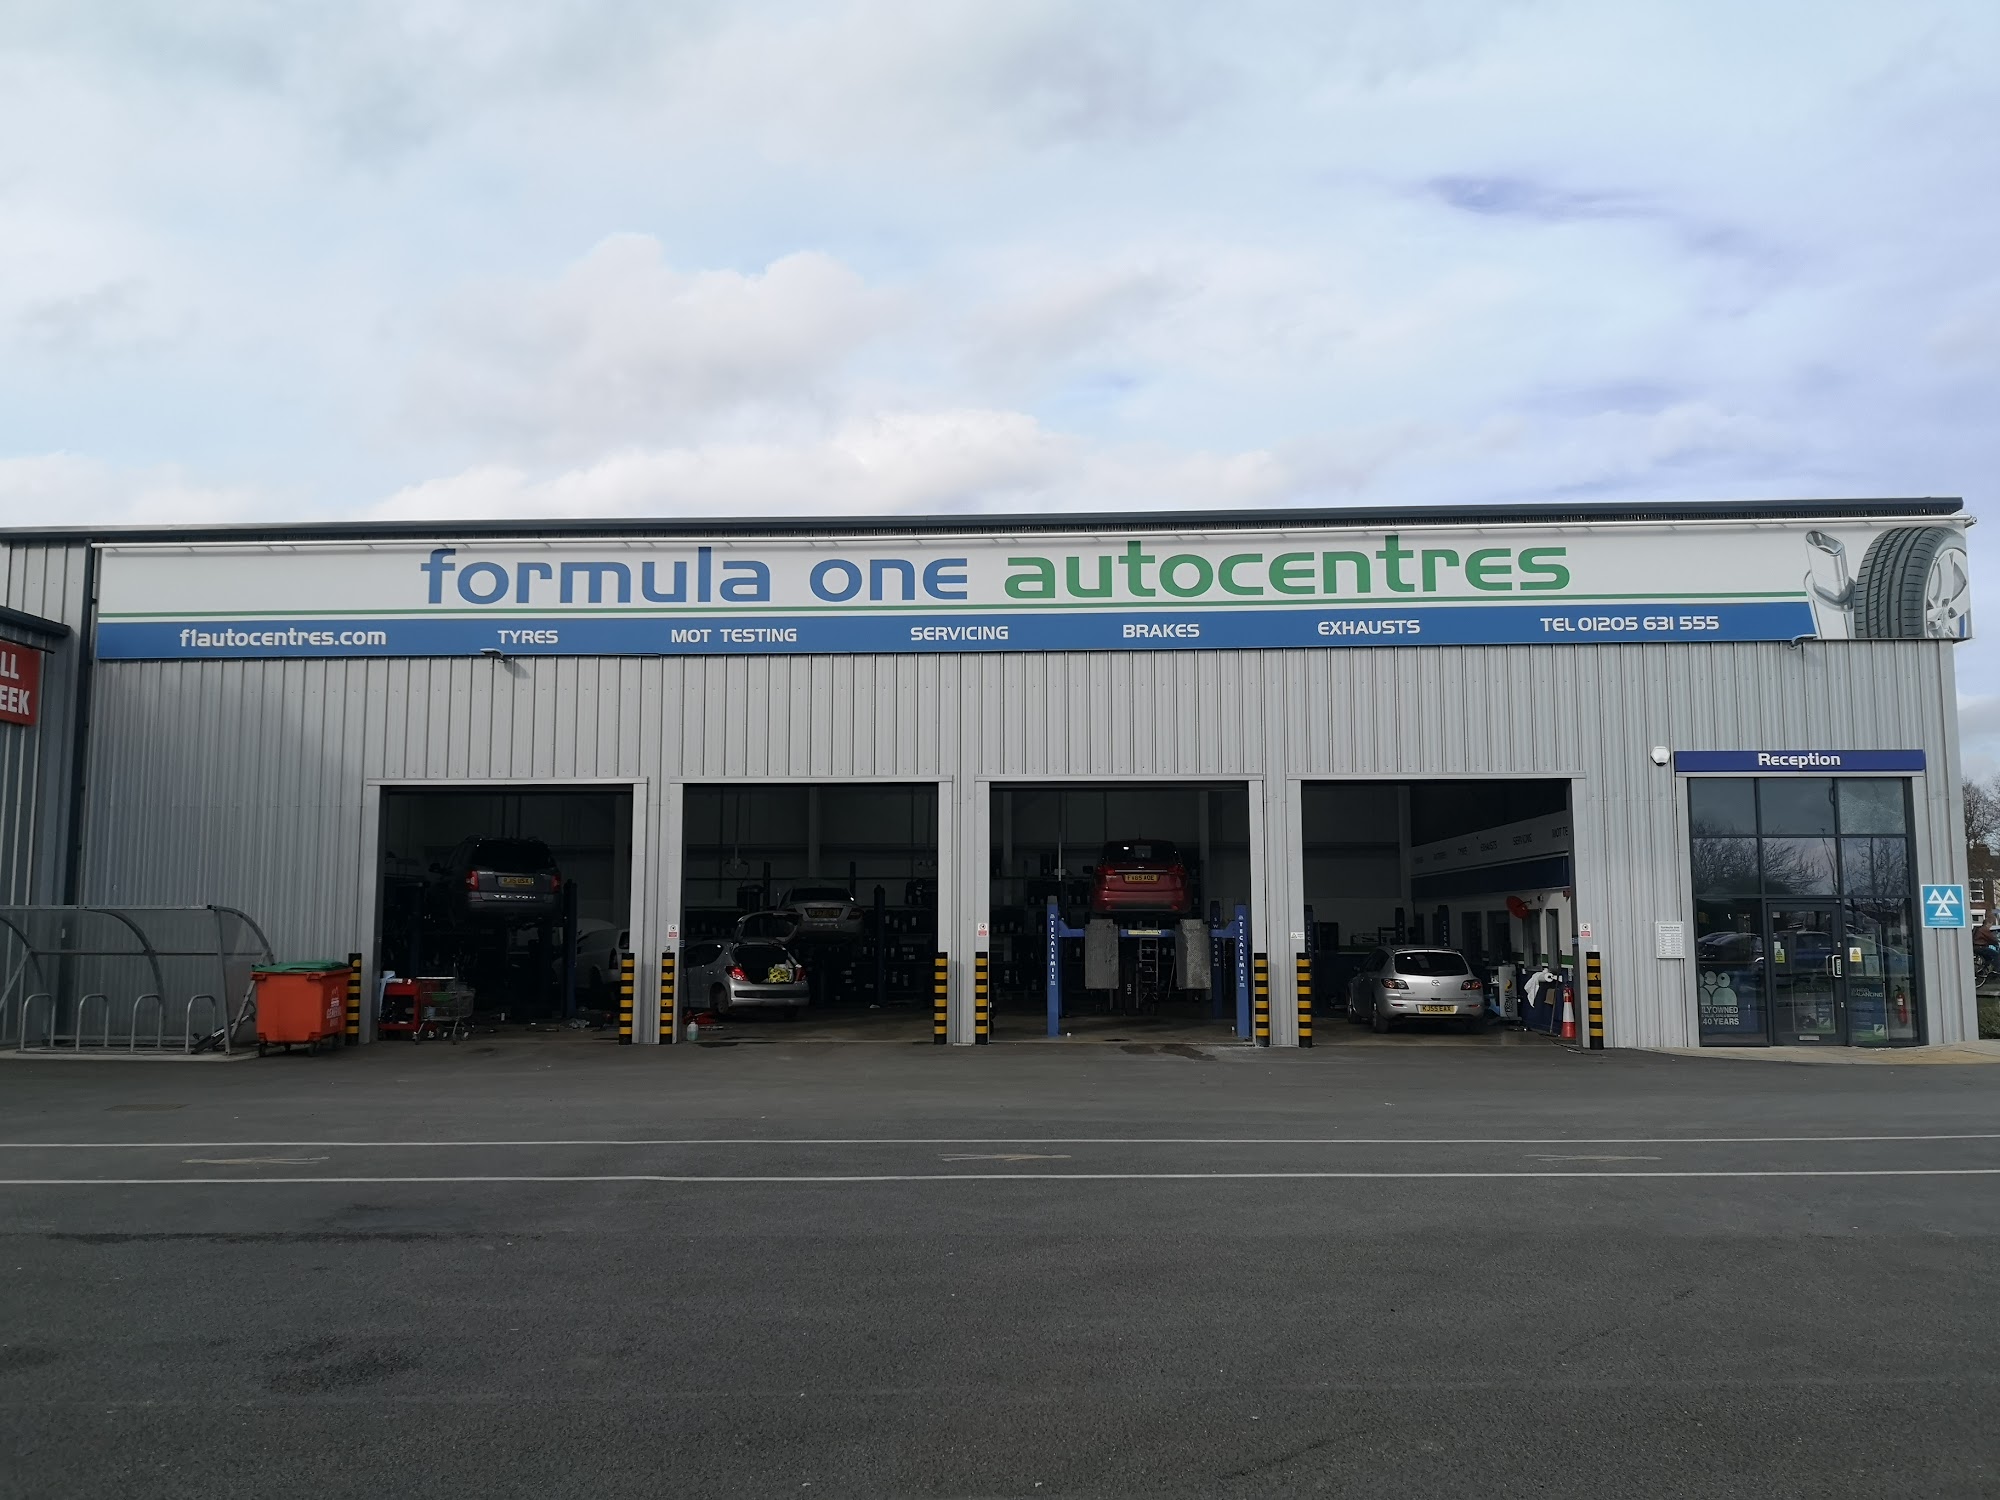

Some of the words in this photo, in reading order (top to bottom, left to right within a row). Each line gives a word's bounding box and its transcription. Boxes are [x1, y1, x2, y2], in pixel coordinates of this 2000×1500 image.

[421, 547, 771, 605] formula
[811, 558, 968, 603] one
[1005, 535, 1571, 598] autocentres
[1123, 623, 1201, 639] BRAKES
[1317, 619, 1422, 636] EXHAUSTS
[1540, 617, 1574, 632] TEL
[1575, 616, 1639, 632] 01205
[1643, 616, 1674, 631] 631
[1679, 615, 1720, 630] 555
[180, 627, 387, 648] f1autocentres.com
[497, 629, 559, 644] TYRES
[670, 629, 712, 644] MOT
[720, 628, 797, 643] TESTING
[910, 625, 1009, 641] SERVICING
[1758, 753, 1842, 769] Reception
[1713, 1018, 1740, 1026] YEARS
